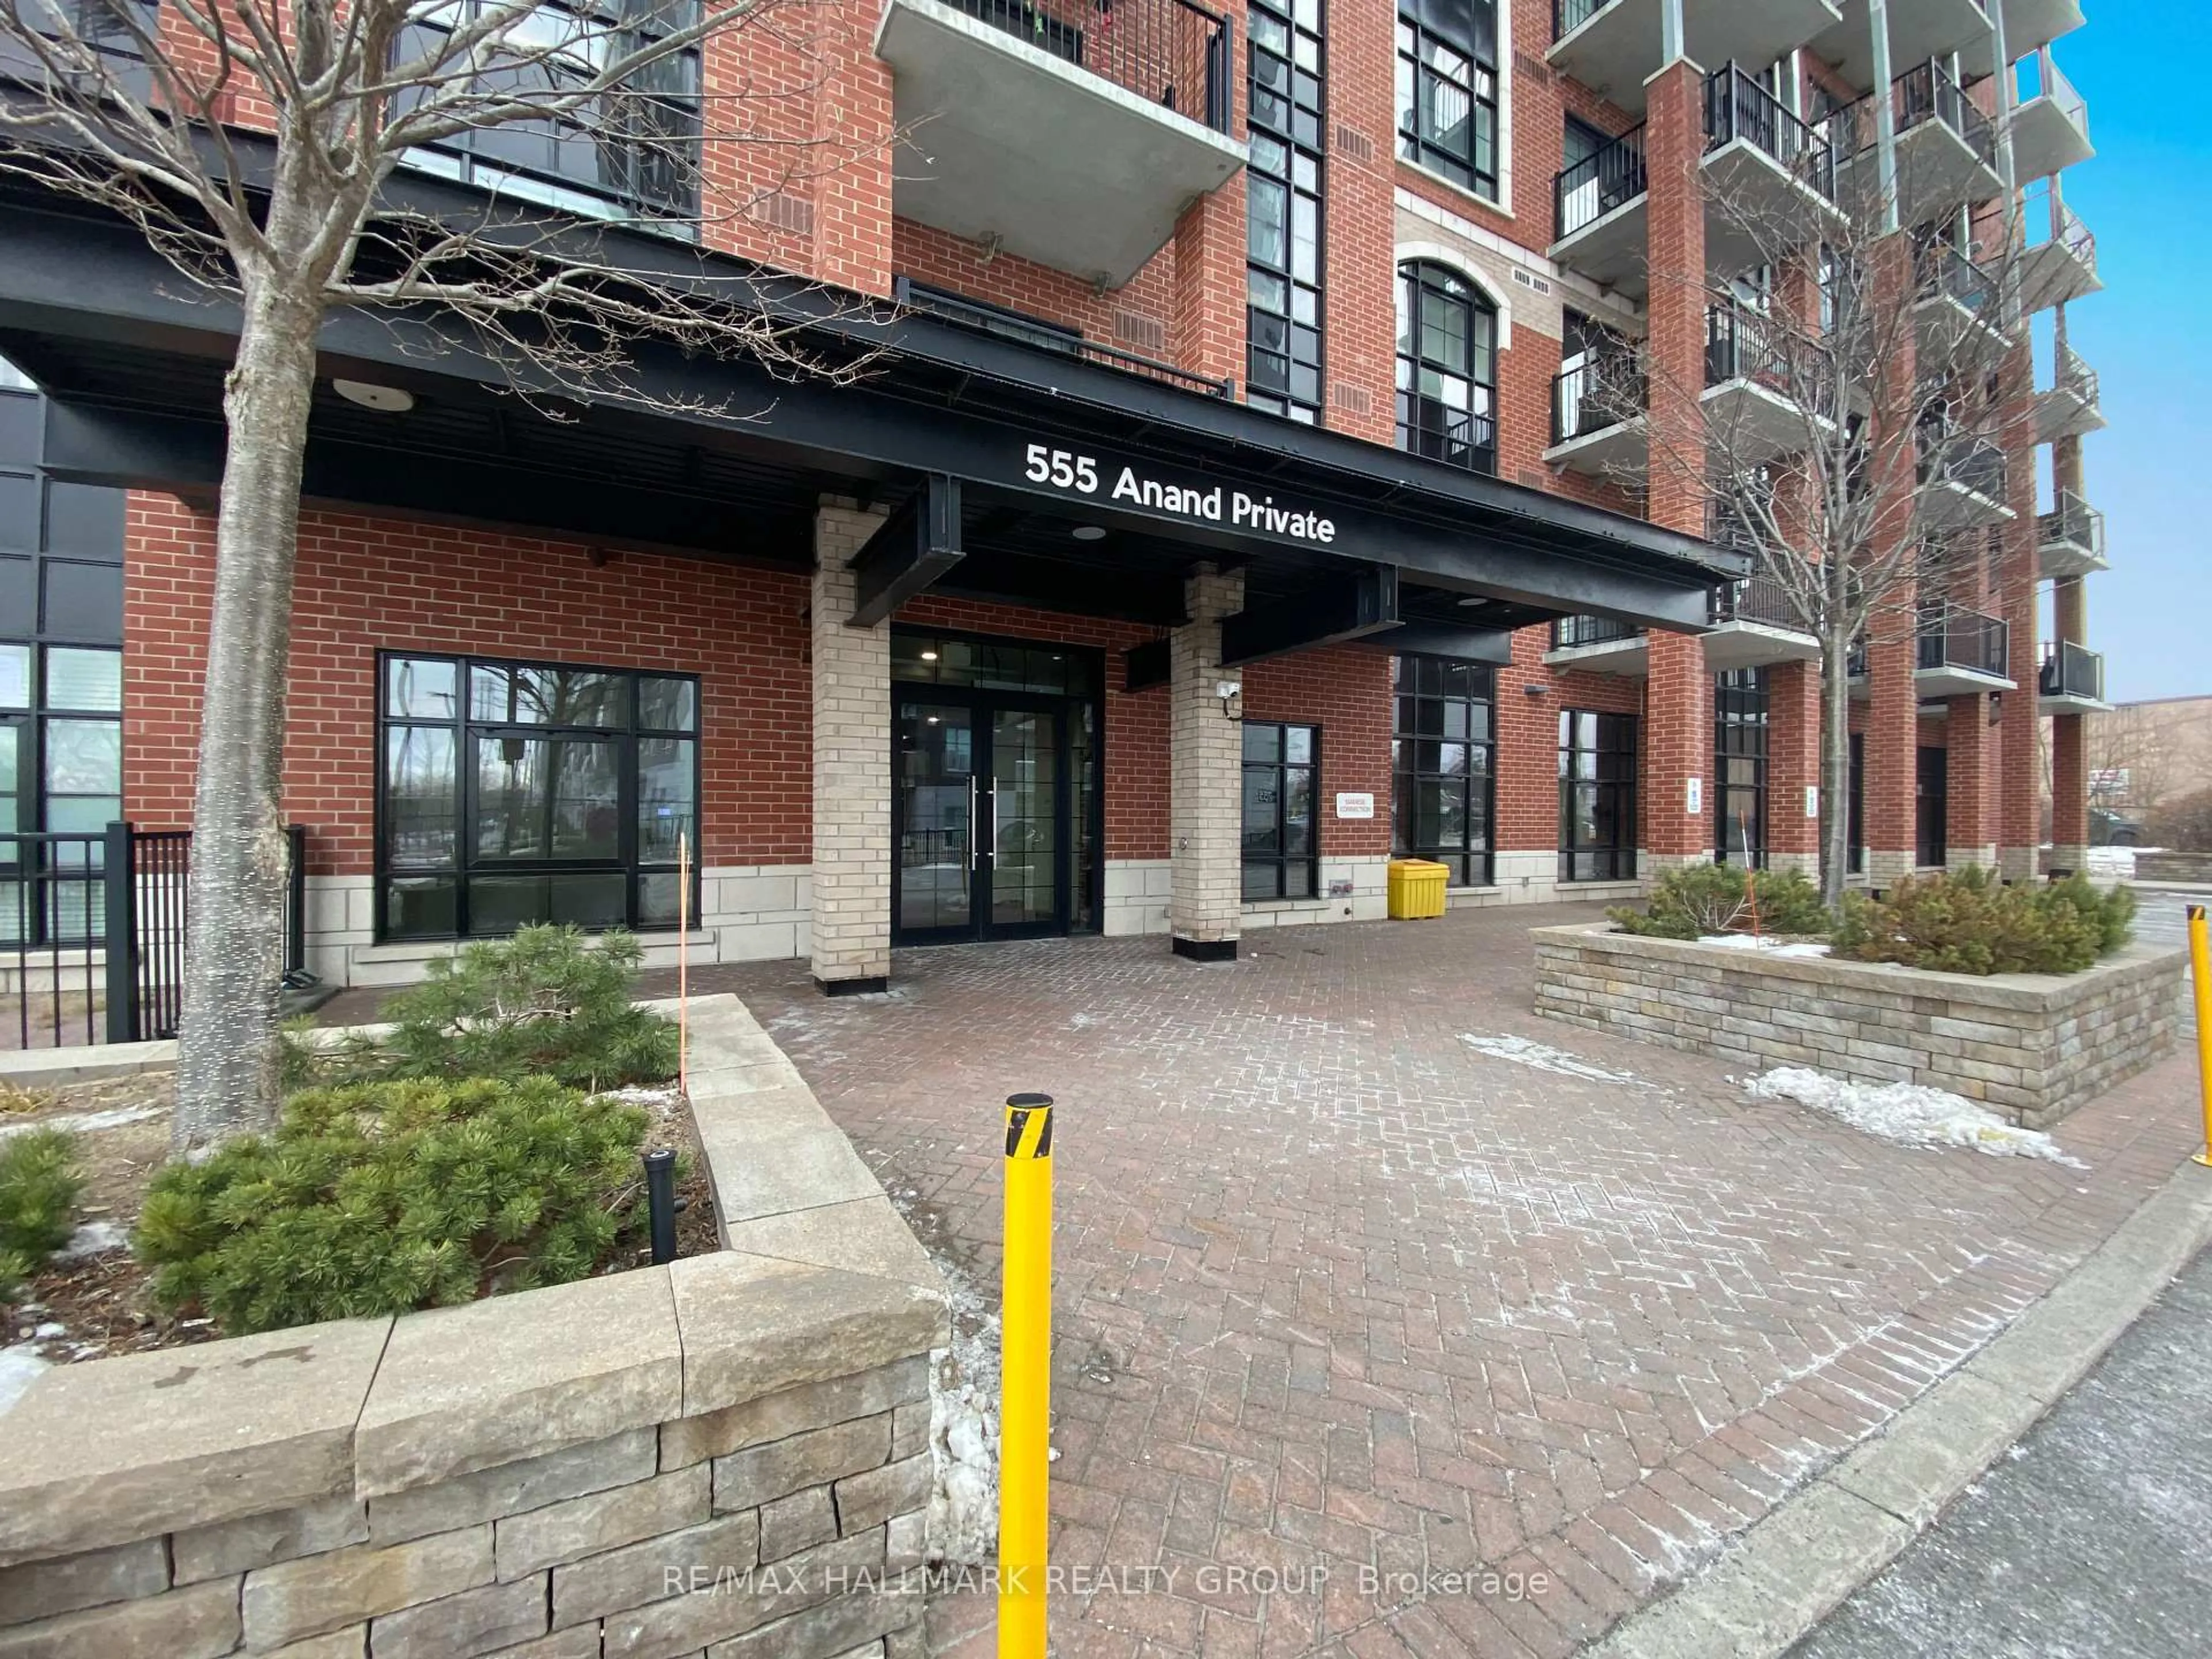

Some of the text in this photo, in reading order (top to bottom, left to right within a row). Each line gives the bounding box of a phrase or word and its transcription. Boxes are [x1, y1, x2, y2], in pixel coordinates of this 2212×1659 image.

[1025, 444, 1335, 543] 555 Anand Private
